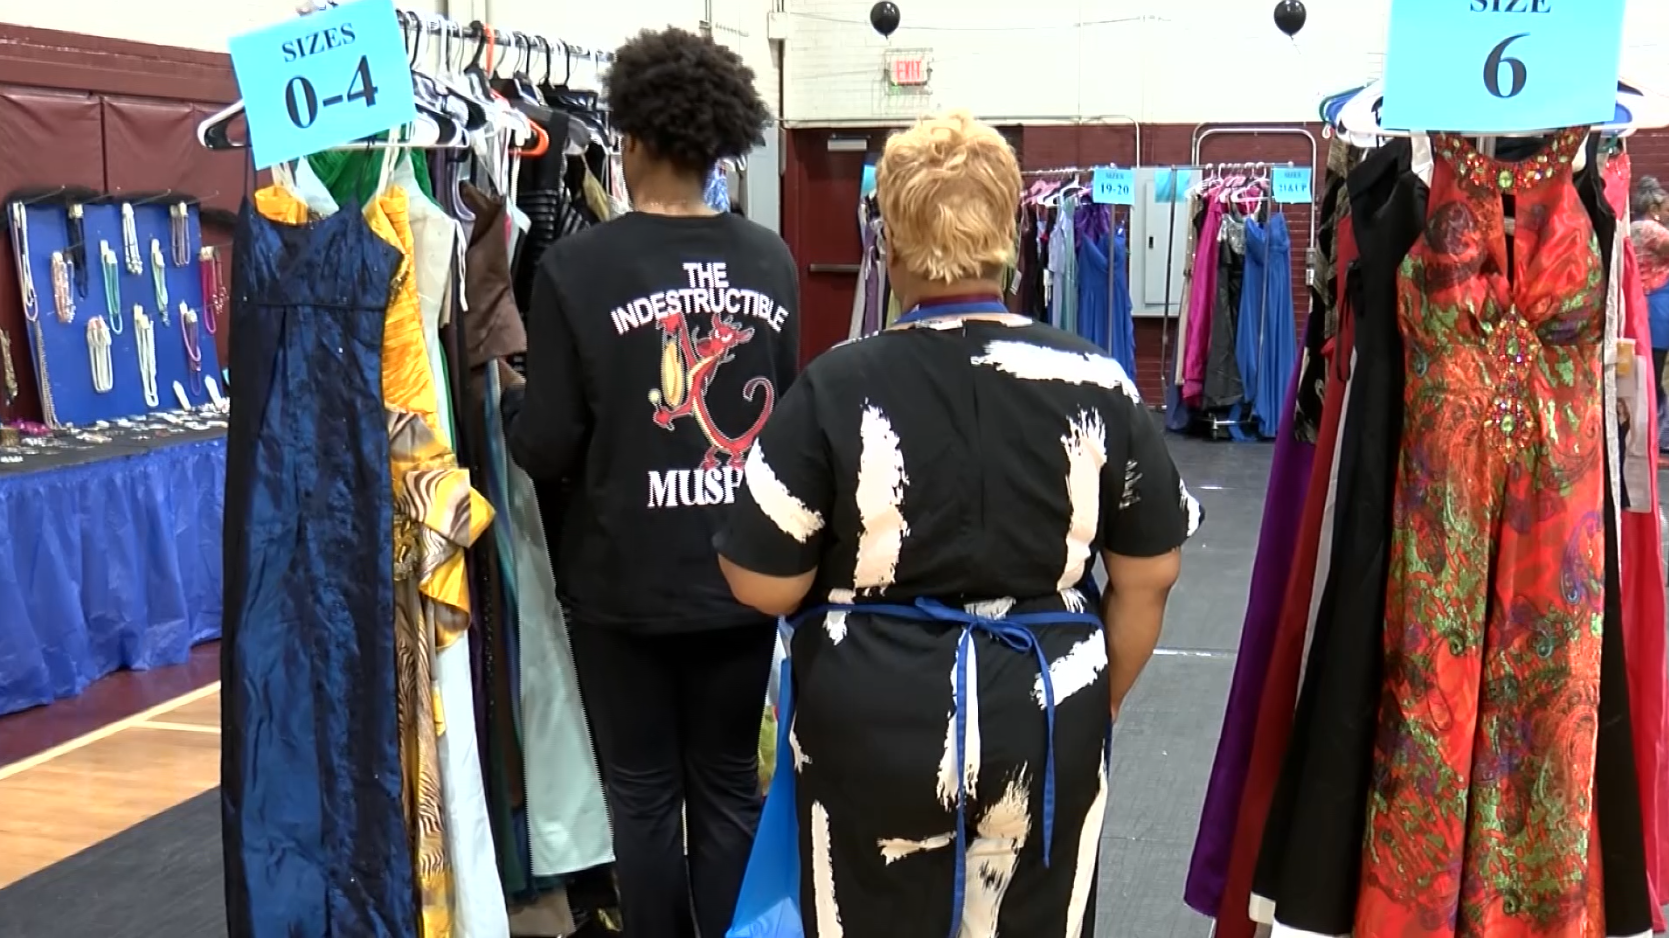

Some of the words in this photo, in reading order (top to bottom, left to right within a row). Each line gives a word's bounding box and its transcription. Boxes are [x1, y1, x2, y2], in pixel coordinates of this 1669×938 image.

[281, 23, 356, 62] SIZES
[896, 60, 921, 80] EXIT
[1483, 32, 1530, 98] 6
[285, 55, 378, 129] 0-4
[1101, 182, 1129, 195] 19-20
[683, 262, 729, 288] THE
[610, 288, 789, 335] INDESTRUCTIBLE
